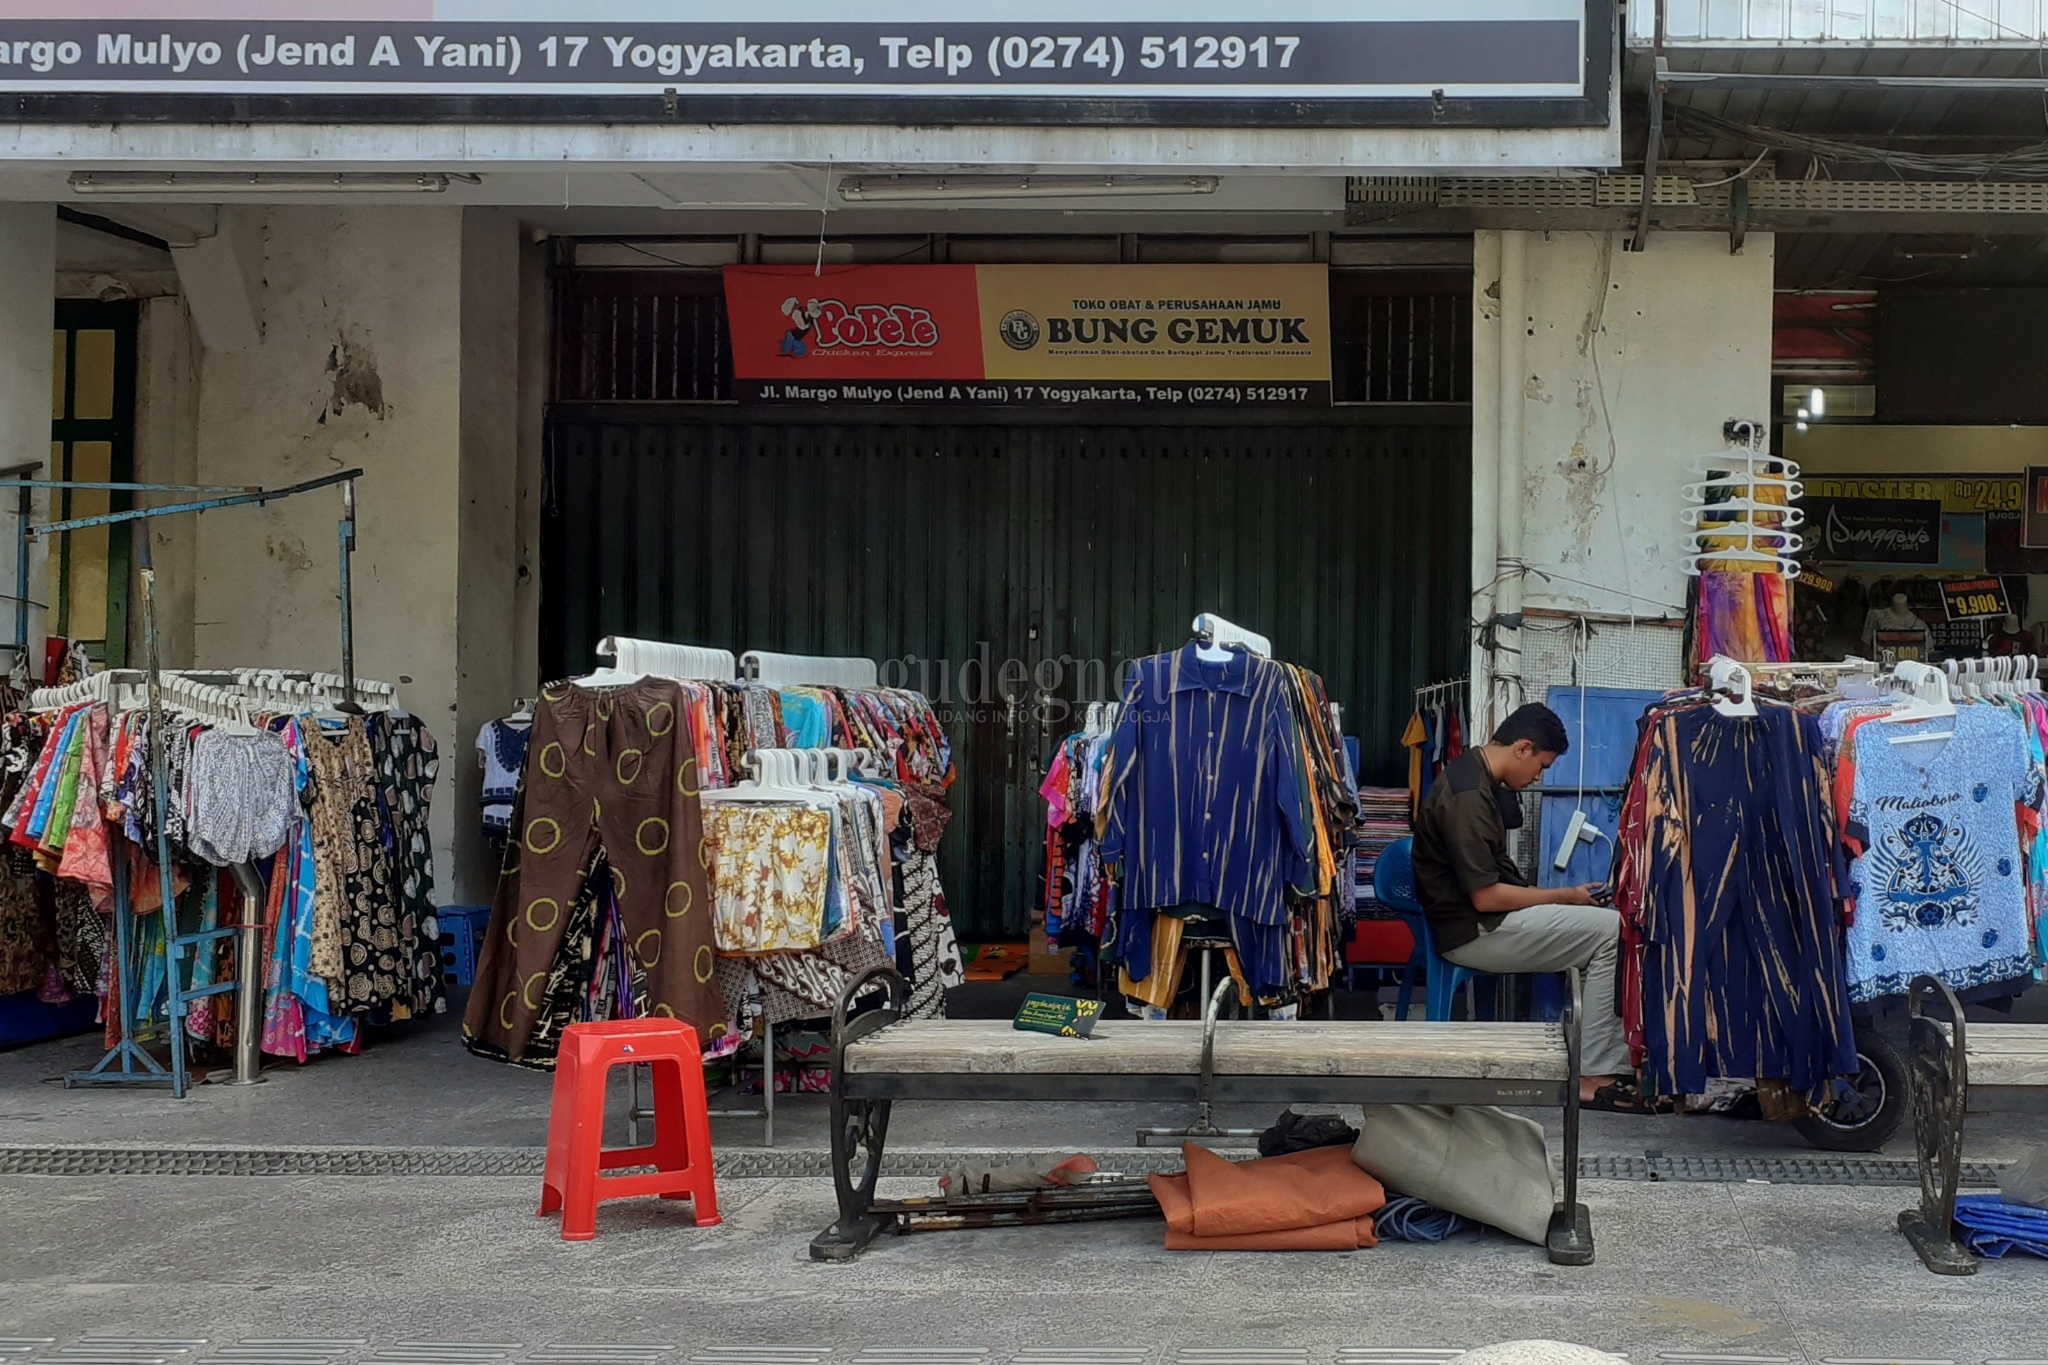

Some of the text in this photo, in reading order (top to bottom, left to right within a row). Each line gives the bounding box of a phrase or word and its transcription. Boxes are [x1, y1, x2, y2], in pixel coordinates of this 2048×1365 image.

[97, 34, 222, 73] Mulyo
[236, 35, 355, 74] (Jend
[369, 36, 401, 66] A
[415, 36, 522, 75] Yani)
[539, 36, 589, 67] 17
[603, 37, 864, 76] Yogyakarta,
[880, 37, 973, 76] Telp
[987, 37, 1125, 77] (0274)
[1140, 37, 1300, 69] 512917
[1072, 299, 1281, 311] TOKO OBAT & PERUSAHAAN JAMU
[1046, 317, 1158, 344] BUNG
[1167, 317, 1310, 344] GEMUK
[811, 348, 934, 357] Chicken Express
[760, 386, 1308, 403] Jl. Margo Mulyo (Jend A Yani) 17 Yogyakarta, Telp (0274) 512917
[1875, 791, 1963, 812] Malioboro
